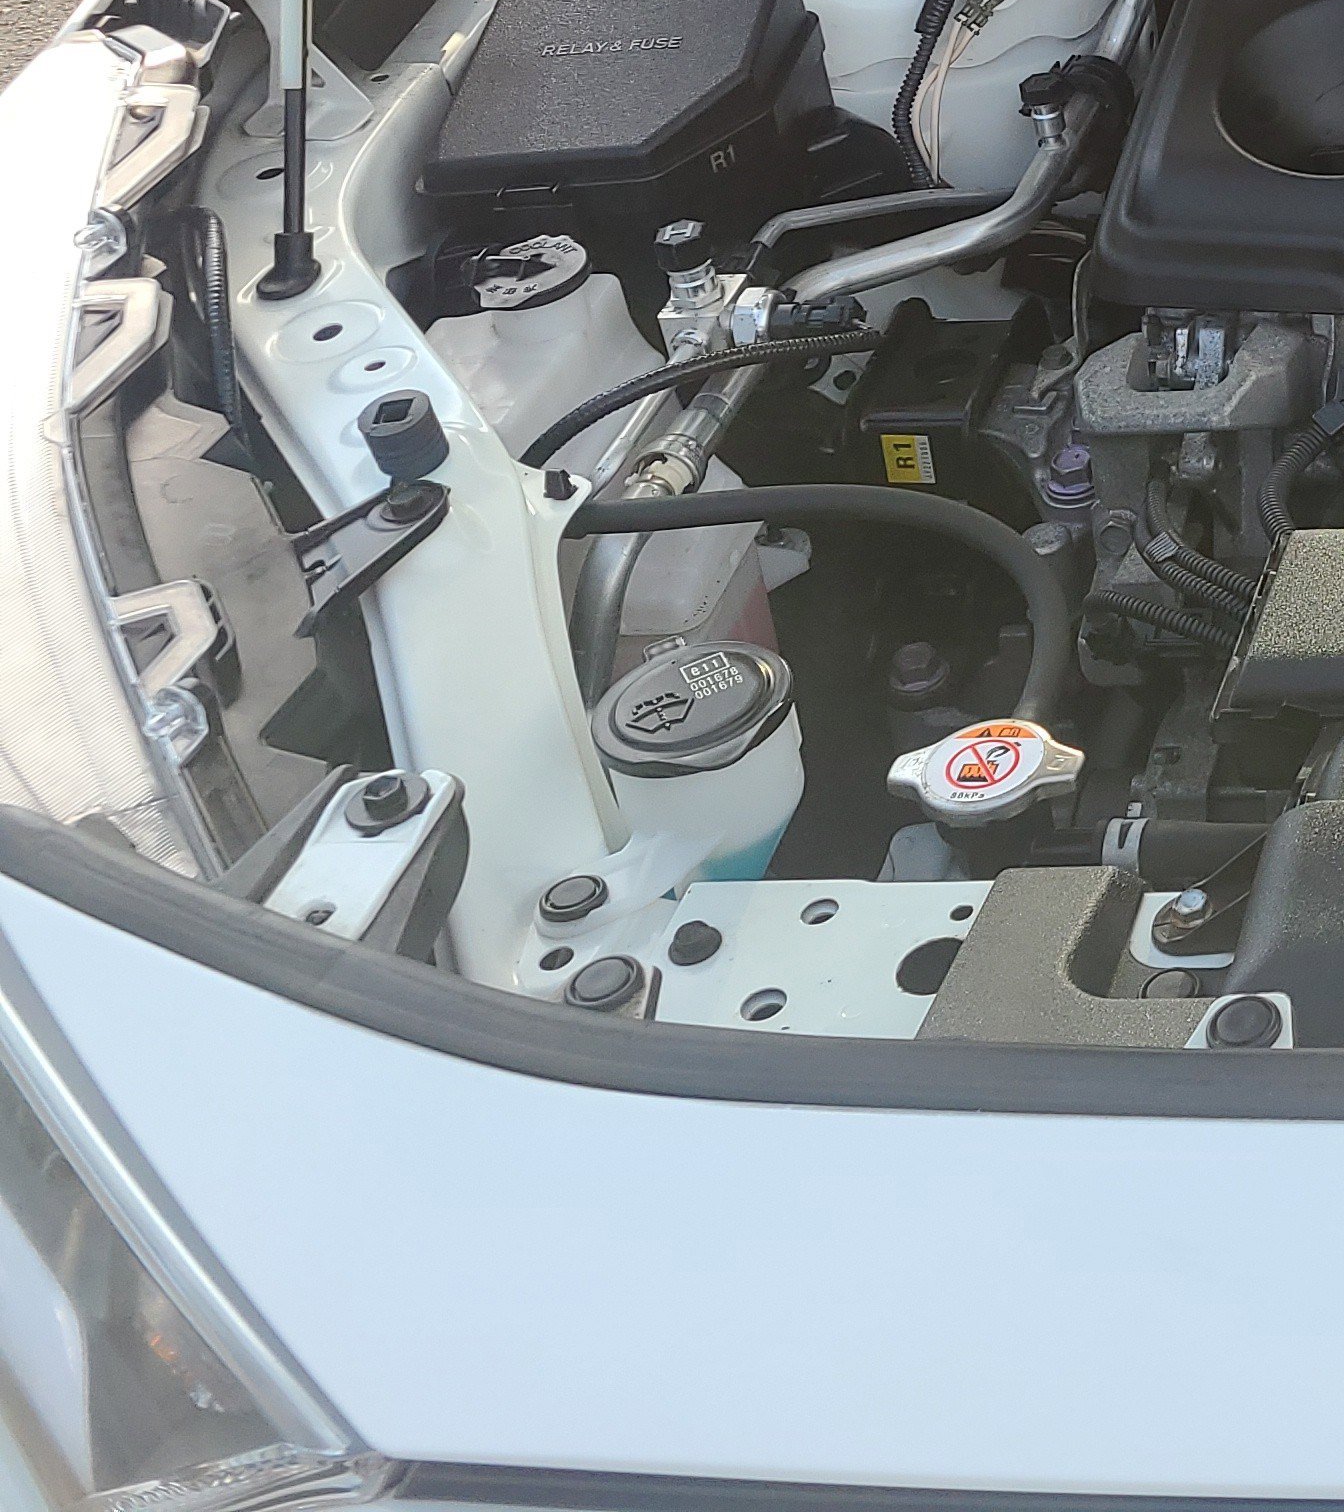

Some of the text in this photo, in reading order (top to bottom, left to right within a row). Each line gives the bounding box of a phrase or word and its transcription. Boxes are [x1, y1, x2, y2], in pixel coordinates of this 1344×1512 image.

[541, 40, 607, 57] RELAY
[629, 36, 683, 52] FUSE
[709, 143, 737, 174] R1
[663, 222, 695, 241] H
[509, 240, 578, 255] COOLANT
[892, 443, 916, 470] R1
[690, 659, 719, 676] e11
[690, 666, 739, 691] 001678
[695, 675, 744, 700] 001679
